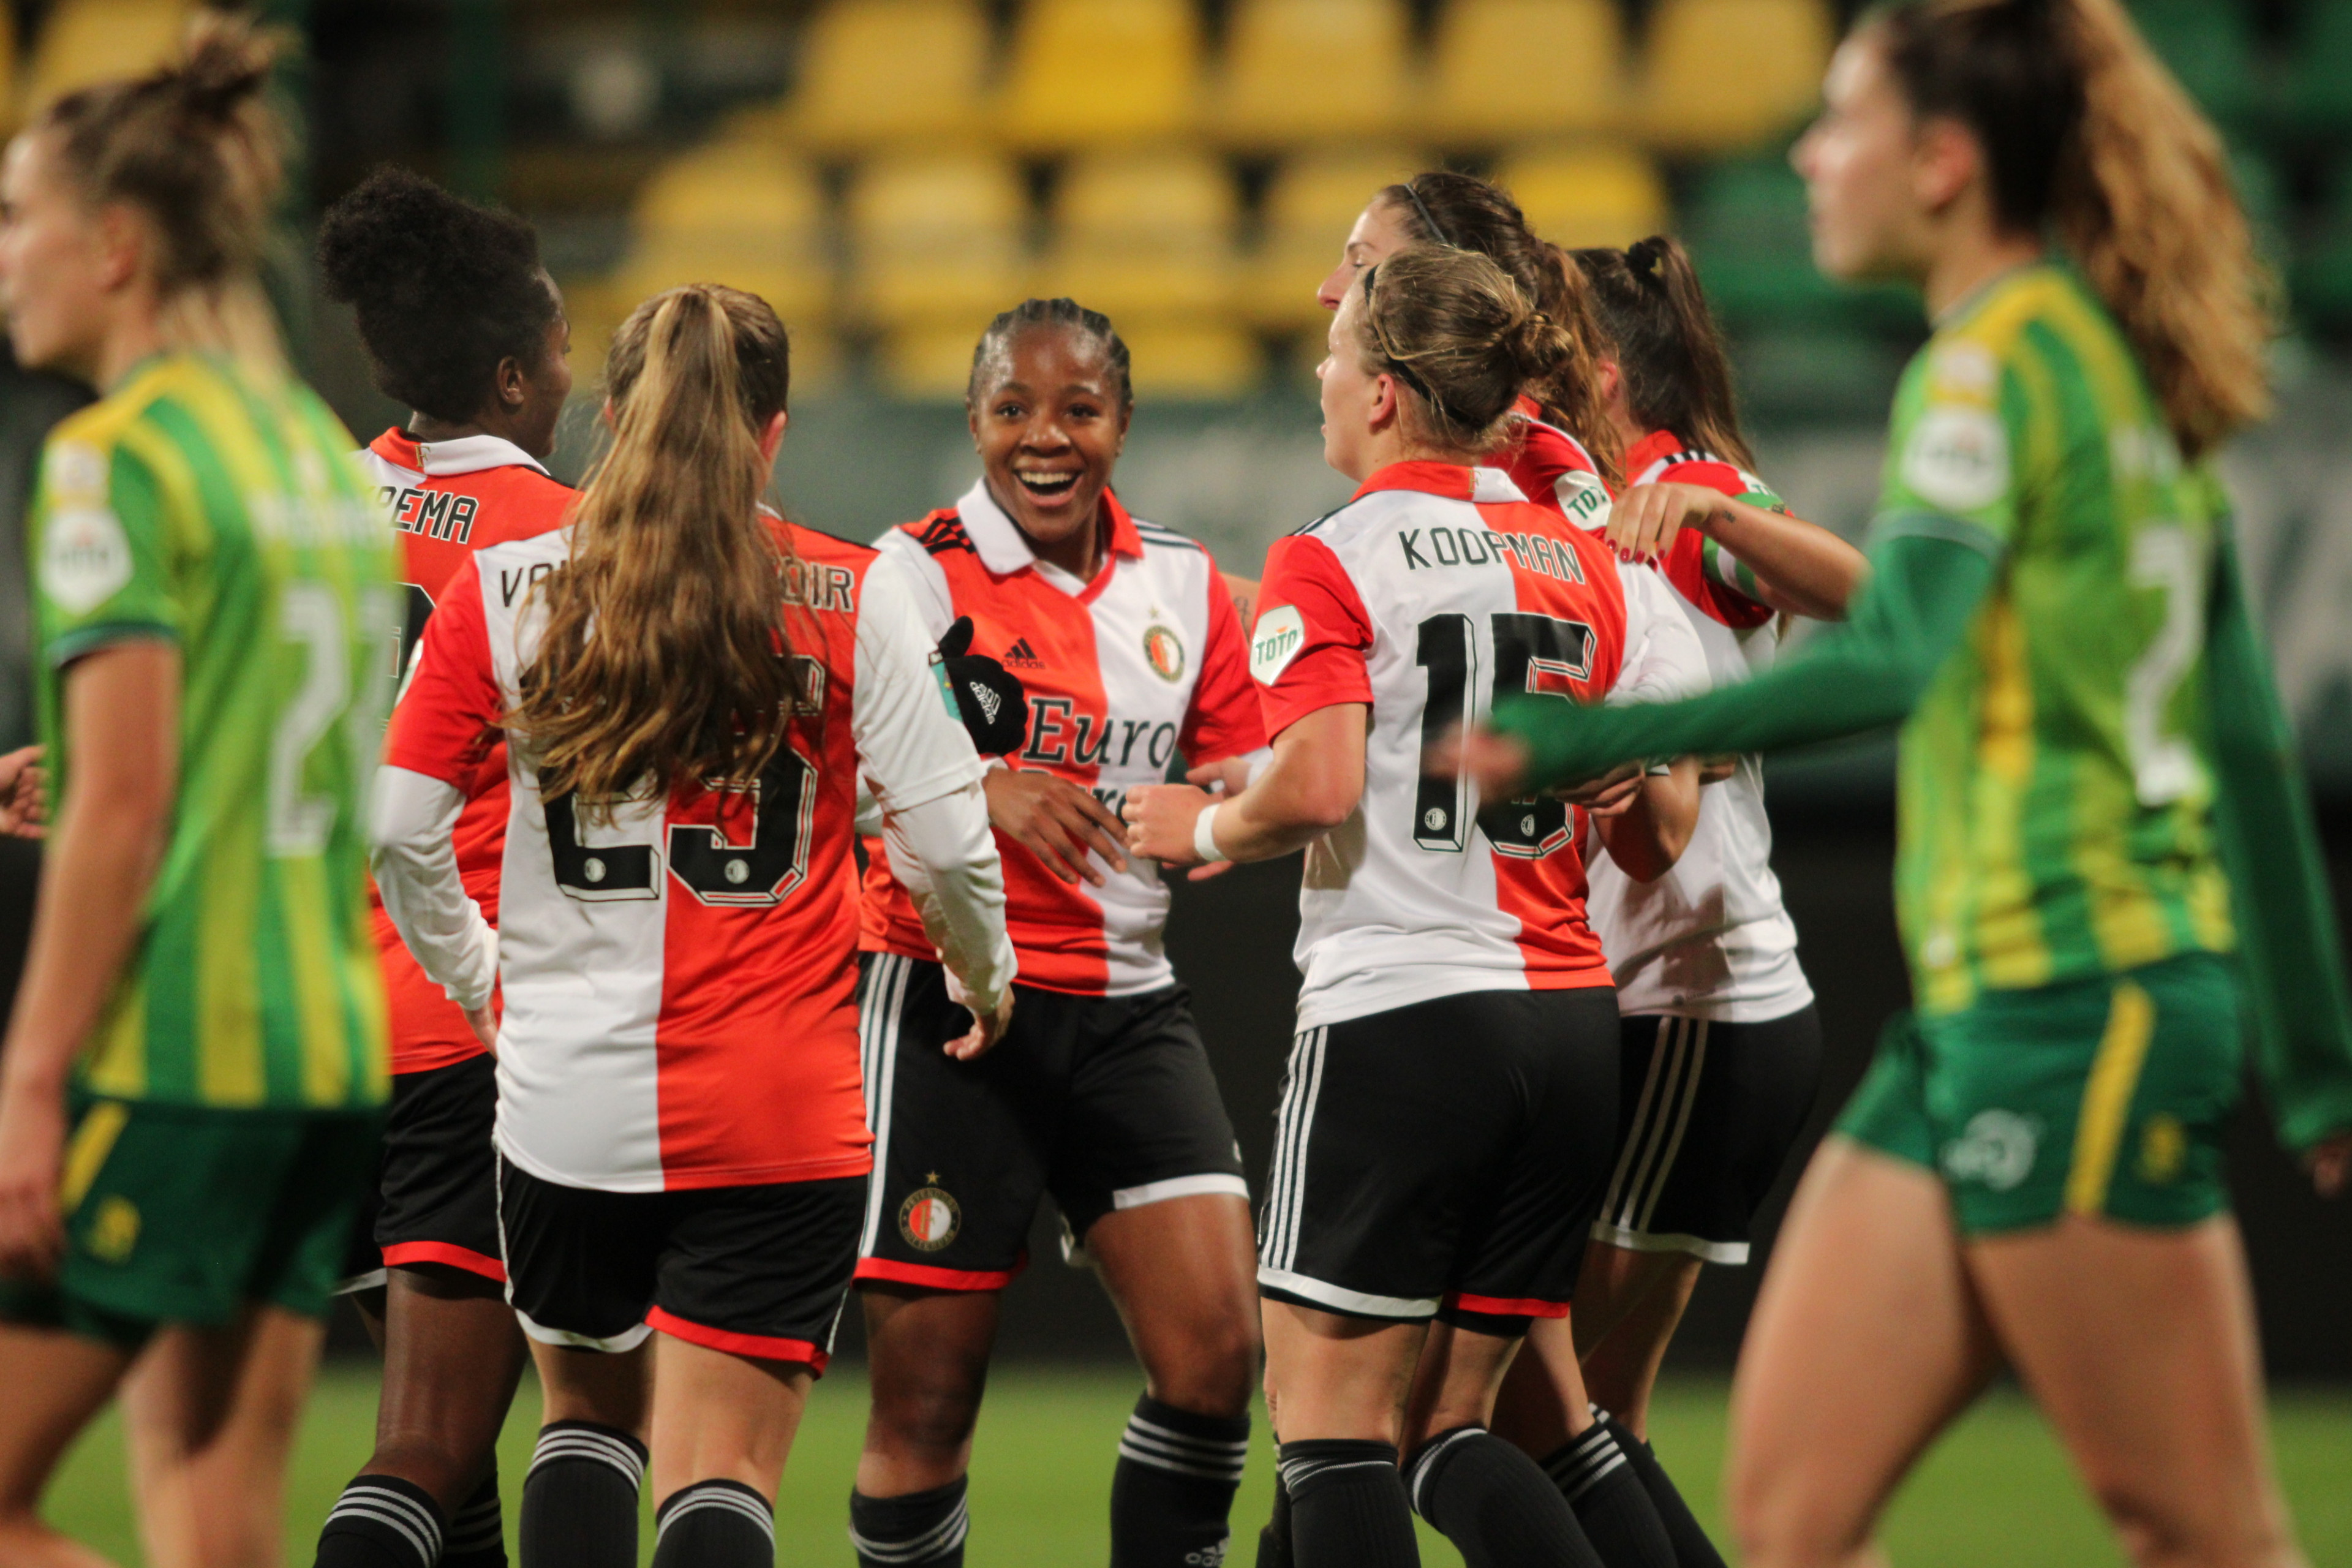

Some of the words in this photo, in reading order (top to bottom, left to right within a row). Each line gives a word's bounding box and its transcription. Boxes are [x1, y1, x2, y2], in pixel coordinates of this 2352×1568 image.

[1398, 526, 1586, 584] KOOPMAN
[1001, 659, 1046, 669] adidas
[1254, 628, 1298, 666] TOTO
[970, 681, 995, 725] adidas
[1021, 696, 1177, 768] Euro
